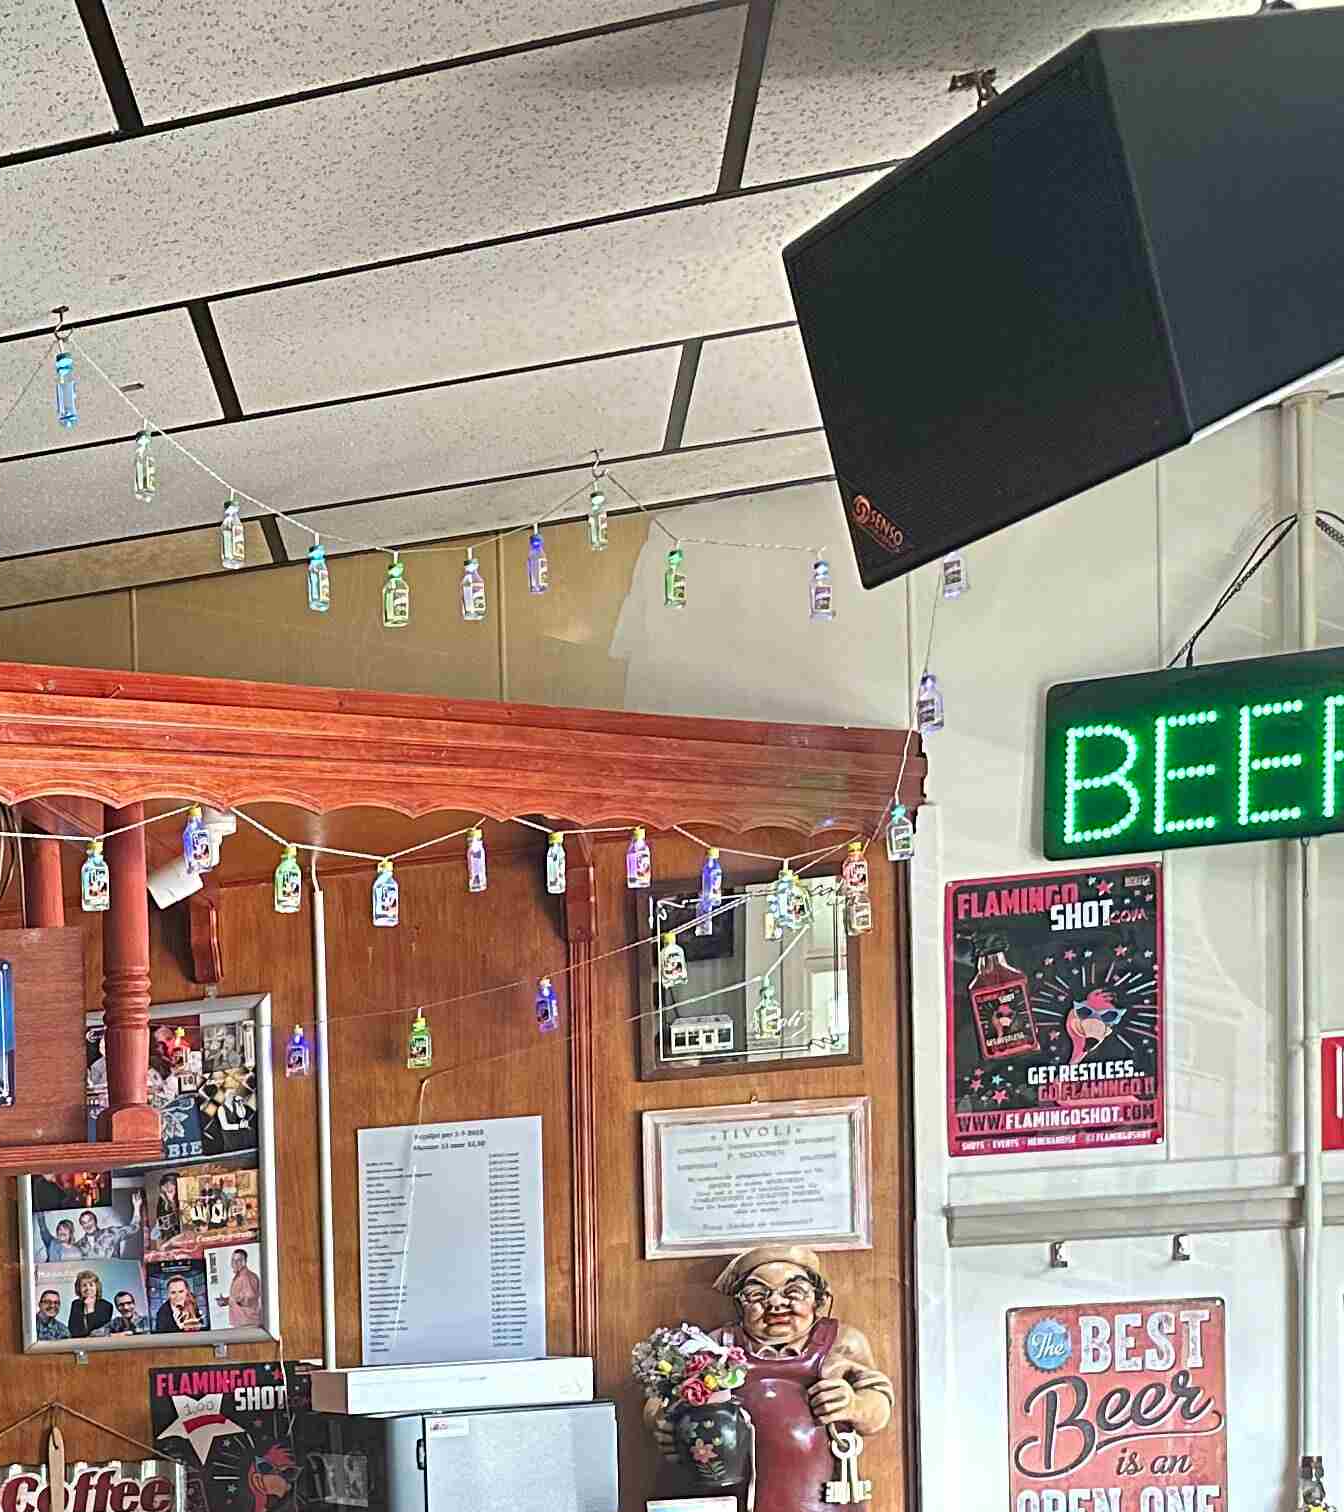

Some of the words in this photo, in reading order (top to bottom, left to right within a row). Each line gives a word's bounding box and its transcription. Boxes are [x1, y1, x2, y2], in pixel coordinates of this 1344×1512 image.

[871, 509, 904, 546] SENSO
[957, 882, 1080, 920] FLAMINGO
[1050, 899, 1114, 931] SHOT
[1027, 1065, 1057, 1085] GET
[1038, 1084, 1058, 1101] GO
[722, 1124, 792, 1140] TIVOLI
[1030, 1331, 1065, 1359] The
[1078, 1308, 1211, 1374] BEST
[156, 1367, 257, 1397] FLAMINGO
[234, 1385, 288, 1412] SHOT
[1014, 1369, 1224, 1479] Beer
[1116, 1447, 1144, 1477] is
[1150, 1454, 1194, 1476] an
